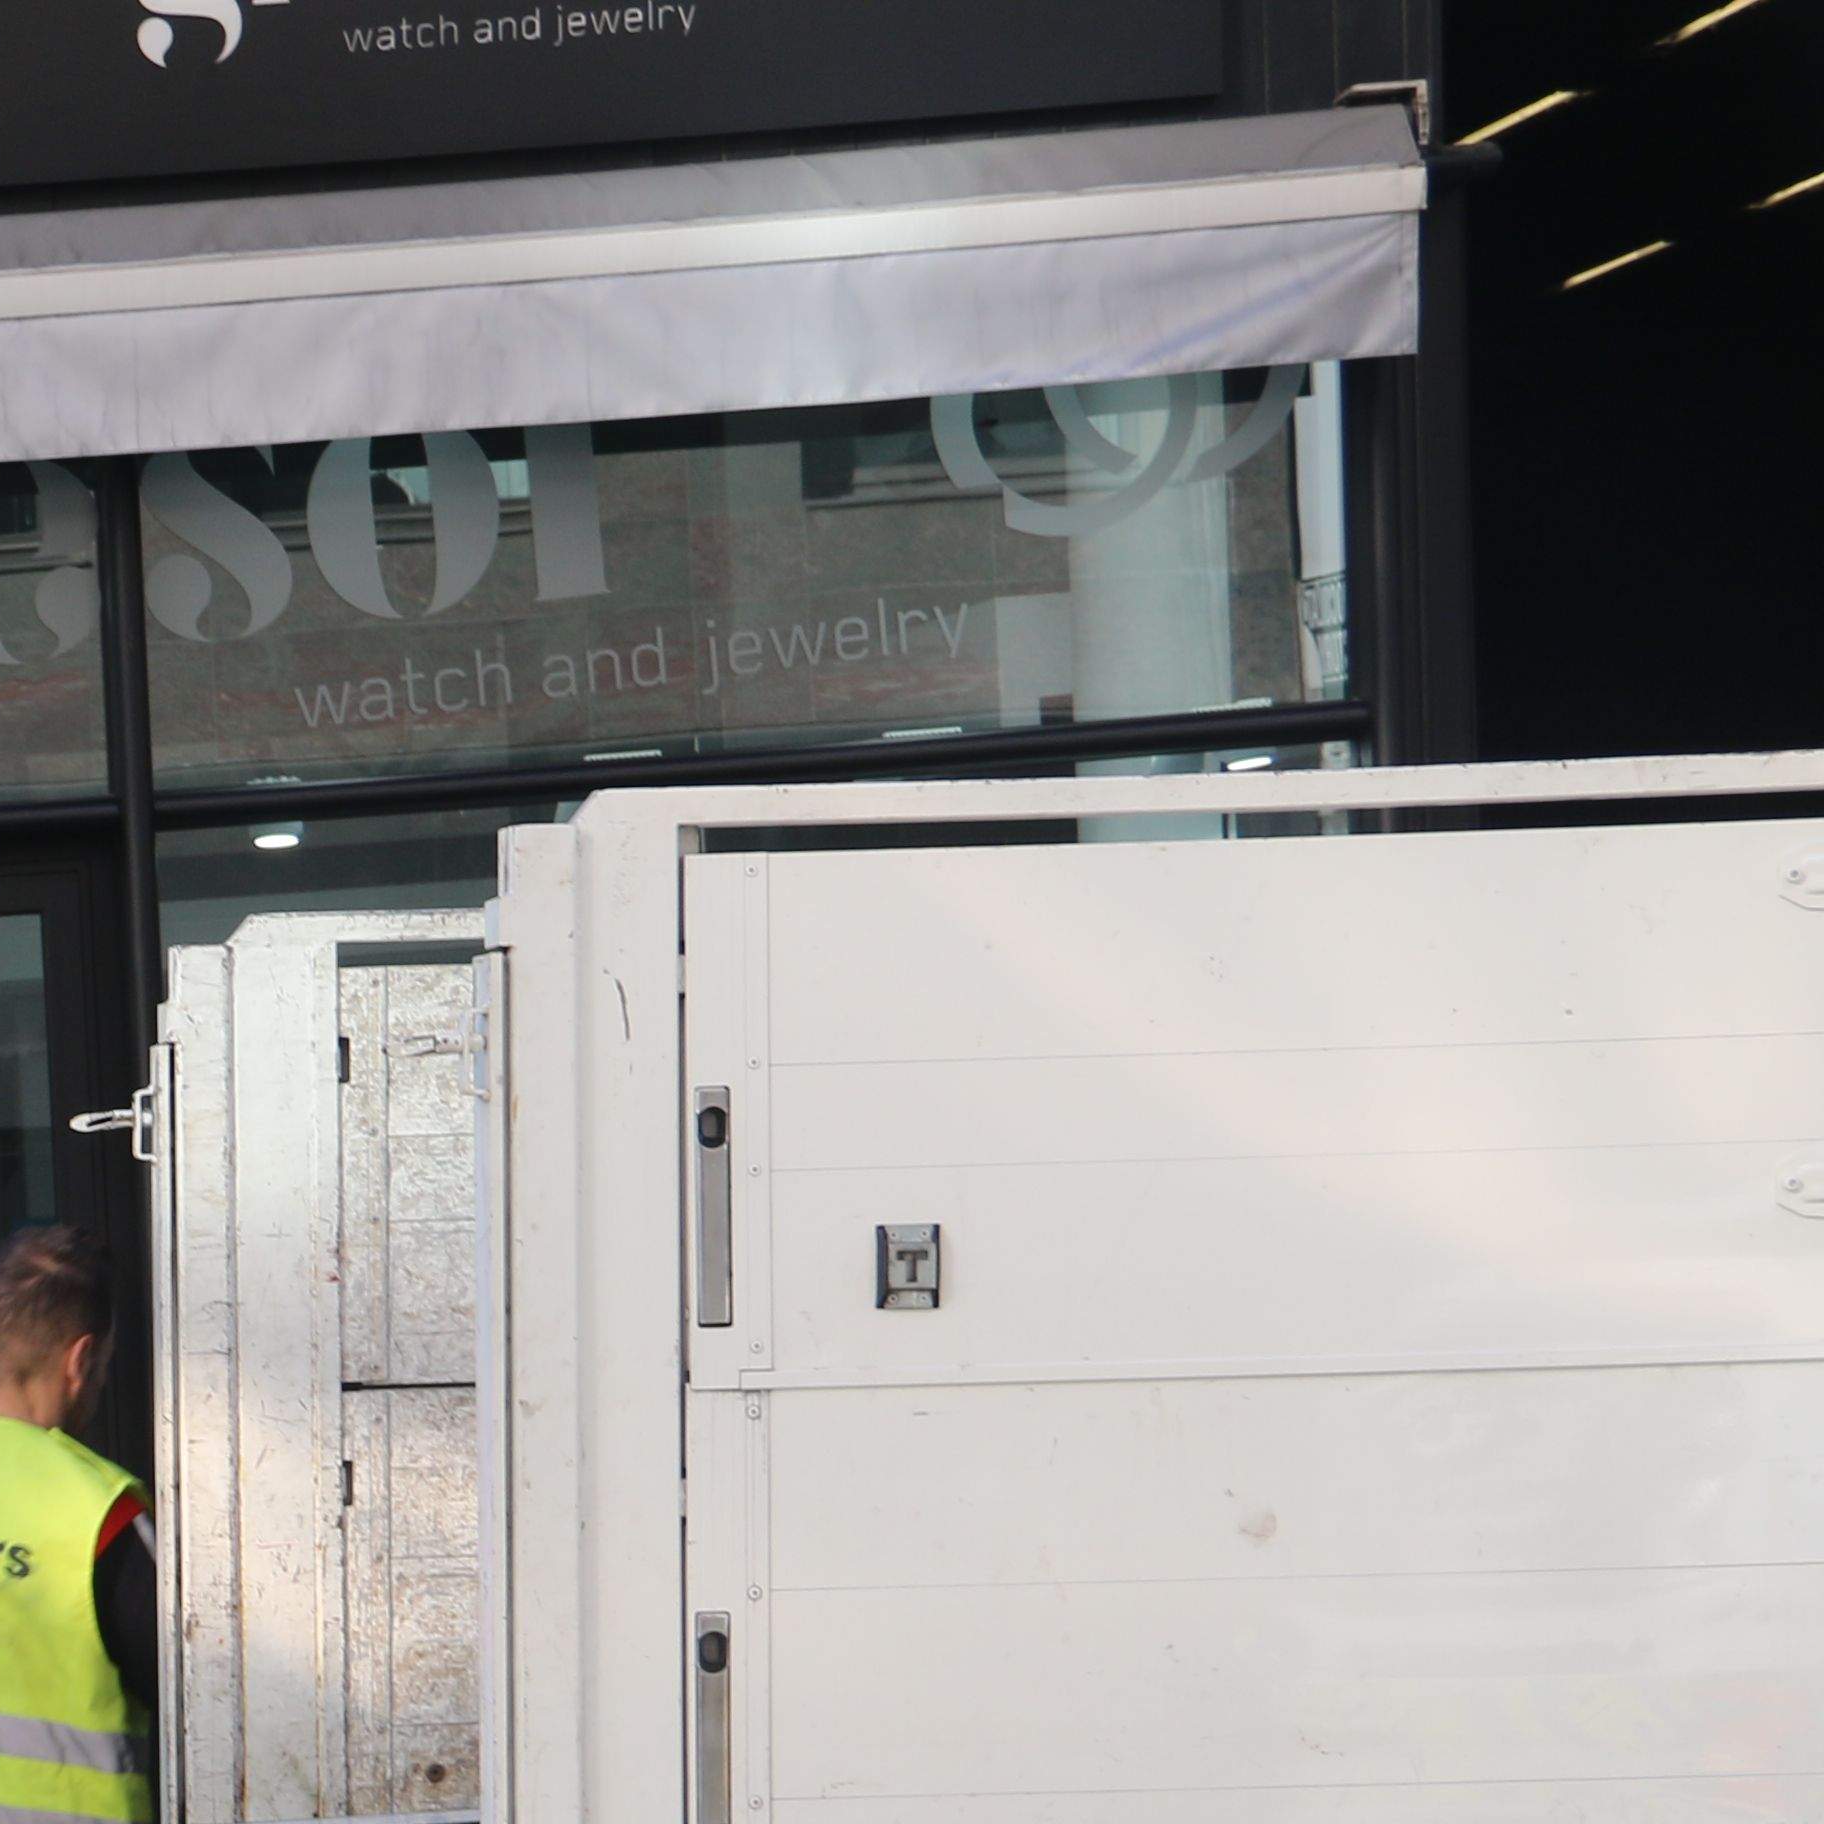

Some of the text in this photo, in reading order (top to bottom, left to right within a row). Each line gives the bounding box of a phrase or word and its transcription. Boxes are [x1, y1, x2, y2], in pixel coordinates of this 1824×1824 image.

[343, 6, 461, 54] watch
[473, 6, 542, 45] and
[552, 1, 697, 48] jewelry
[292, 596, 969, 729] watch and jewelry
